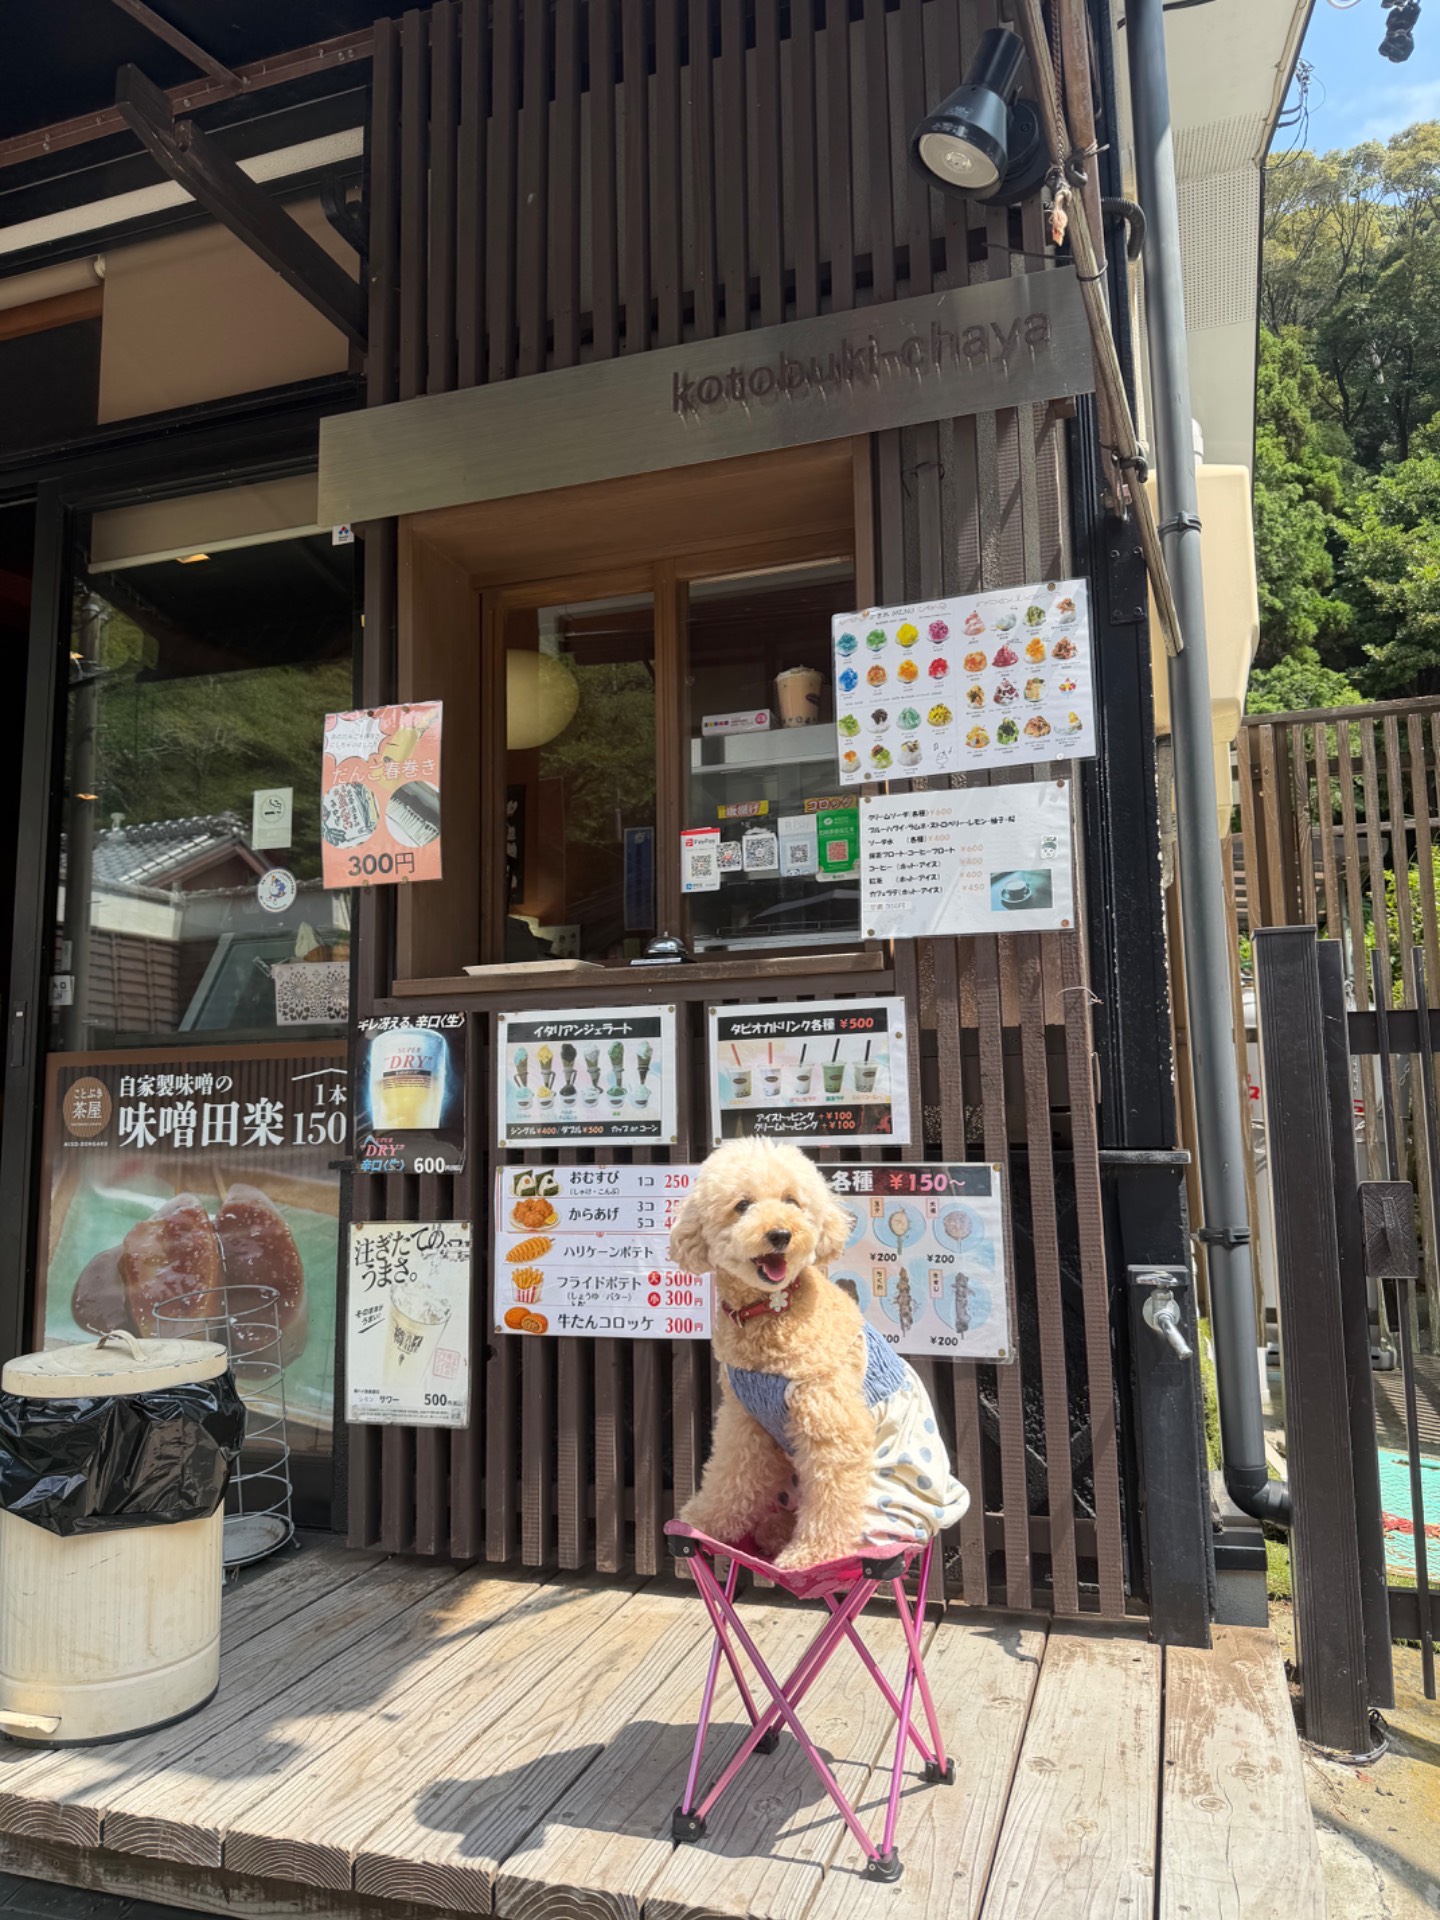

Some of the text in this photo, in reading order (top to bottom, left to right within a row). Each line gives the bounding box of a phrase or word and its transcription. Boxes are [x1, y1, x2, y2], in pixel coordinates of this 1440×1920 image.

[673, 311, 1052, 413] kotobuki-chaya
[333, 759, 437, 784] だんご春巻き
[348, 852, 415, 877] 300円
[533, 1022, 633, 1039] イタリアンジェラート
[730, 1017, 874, 1036] タピオカドリンク各種 ¥500
[73, 1088, 103, 1099] ことぶき
[119, 1074, 233, 1098] 自家製味噌の
[315, 1084, 348, 1106] 1本
[72, 1101, 102, 1119] 茶屋
[117, 1097, 285, 1149] 味噌田楽
[292, 1111, 347, 1146] 150
[413, 1157, 446, 1174] 600
[569, 1170, 620, 1185] おむすび
[832, 1170, 874, 1192] 各種
[569, 1207, 620, 1222] からあげ
[354, 1226, 445, 1267] 注ぎたての
[563, 1245, 654, 1259] ハリケーンポテト
[869, 1252, 897, 1263] ¥200
[926, 1253, 955, 1264] ¥200
[361, 1257, 418, 1293] うまさ。
[557, 1275, 641, 1291] フライドポテト
[664, 1290, 703, 1307] 300円
[557, 1313, 704, 1333] 牛たんコロッケ 300円
[929, 1336, 959, 1346] ¥200
